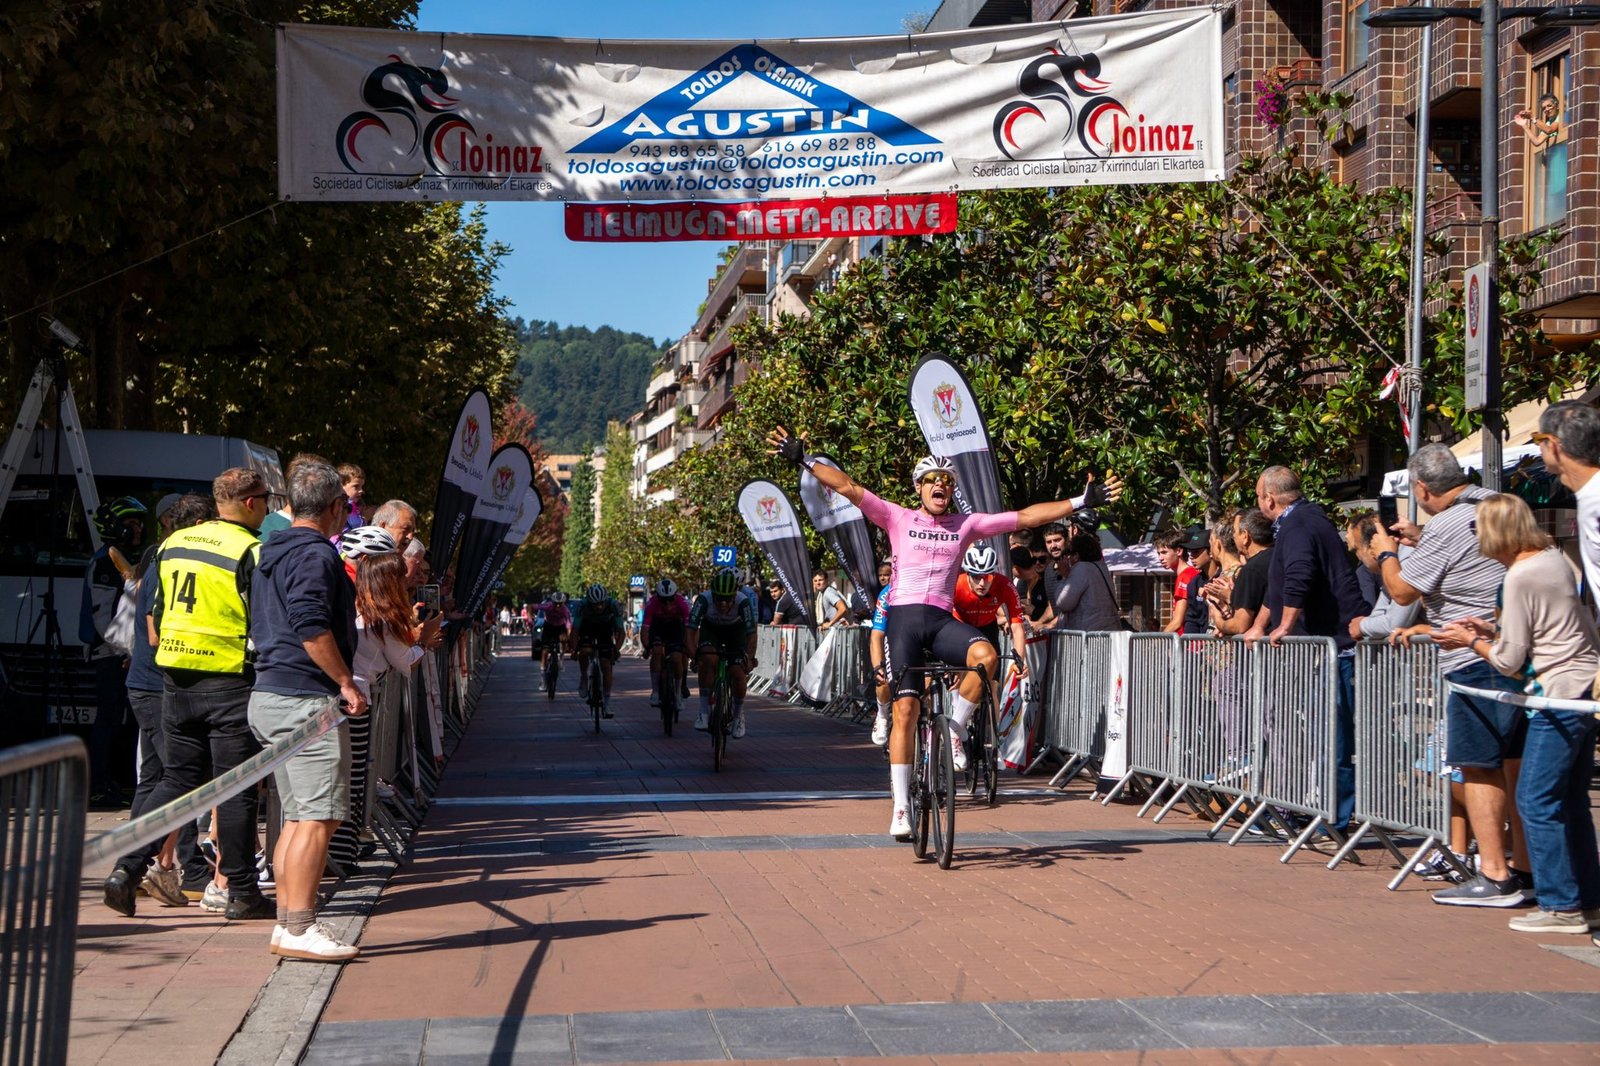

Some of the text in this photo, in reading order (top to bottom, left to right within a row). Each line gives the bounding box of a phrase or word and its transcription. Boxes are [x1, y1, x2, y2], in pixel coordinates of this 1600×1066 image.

[680, 55, 742, 101] TOLDOS
[754, 56, 819, 98] OLANAK
[622, 109, 870, 136] AGUSTIN
[1113, 113, 1195, 153] loinaz
[460, 131, 543, 173] loinaz
[630, 137, 876, 157] 943 88 65 58 616 69 82 88
[568, 150, 944, 175] toldosagustin@toldosagustin.com
[973, 157, 1204, 177] Sociedad Ciclista Loinaz Txirrindulari Elkartea
[313, 176, 362, 190] Sociedad
[365, 178, 403, 190] Ciclista
[510, 179, 553, 191] Elkartea
[620, 173, 877, 192] www.toldosagustin.com
[583, 203, 940, 238] HELMUGA-META-ARRIVE
[908, 529, 960, 541] GOMUR
[717, 549, 733, 562] 50
[169, 570, 197, 614] 14
[631, 577, 644, 585] 100
